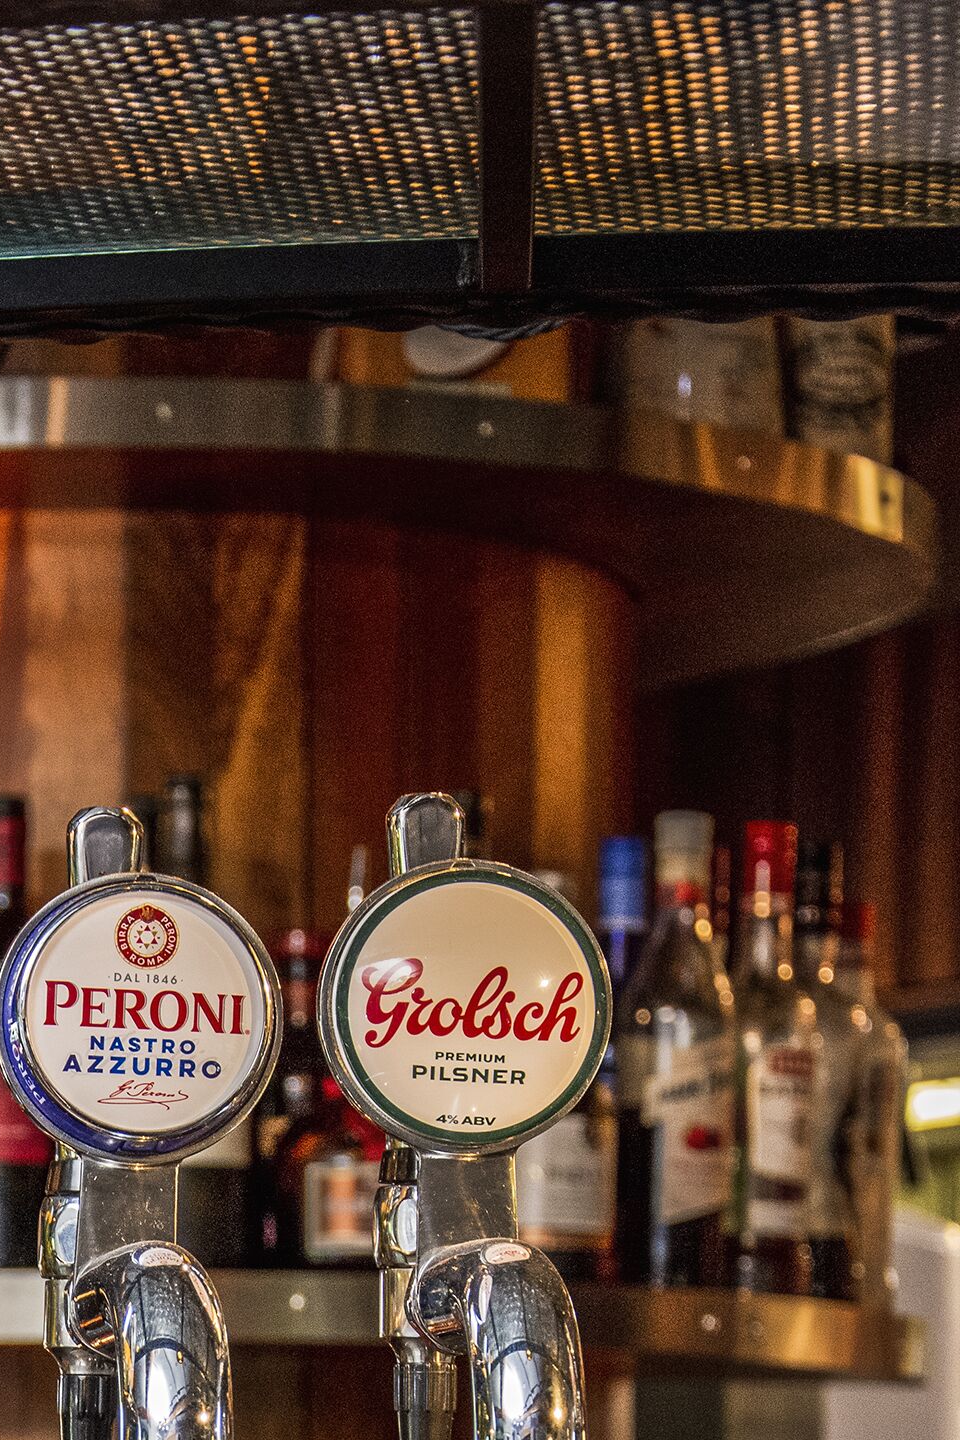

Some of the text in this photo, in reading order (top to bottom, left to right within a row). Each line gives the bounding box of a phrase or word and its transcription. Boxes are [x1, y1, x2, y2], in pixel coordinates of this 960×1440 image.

[118, 915, 136, 951] BIRRA
[161, 916, 176, 954] PERONI
[129, 954, 164, 966] ROMA
[113, 972, 178, 985] DAL 1846
[43, 980, 248, 1035] PERONI
[361, 957, 584, 1048] Grolsch
[90, 1035, 196, 1055] NASTRO
[62, 1054, 222, 1080] AZZURRO
[435, 1051, 506, 1064] PREMIUM
[412, 1064, 527, 1085] PILSNER
[435, 1115, 497, 1127] 4% ABV
